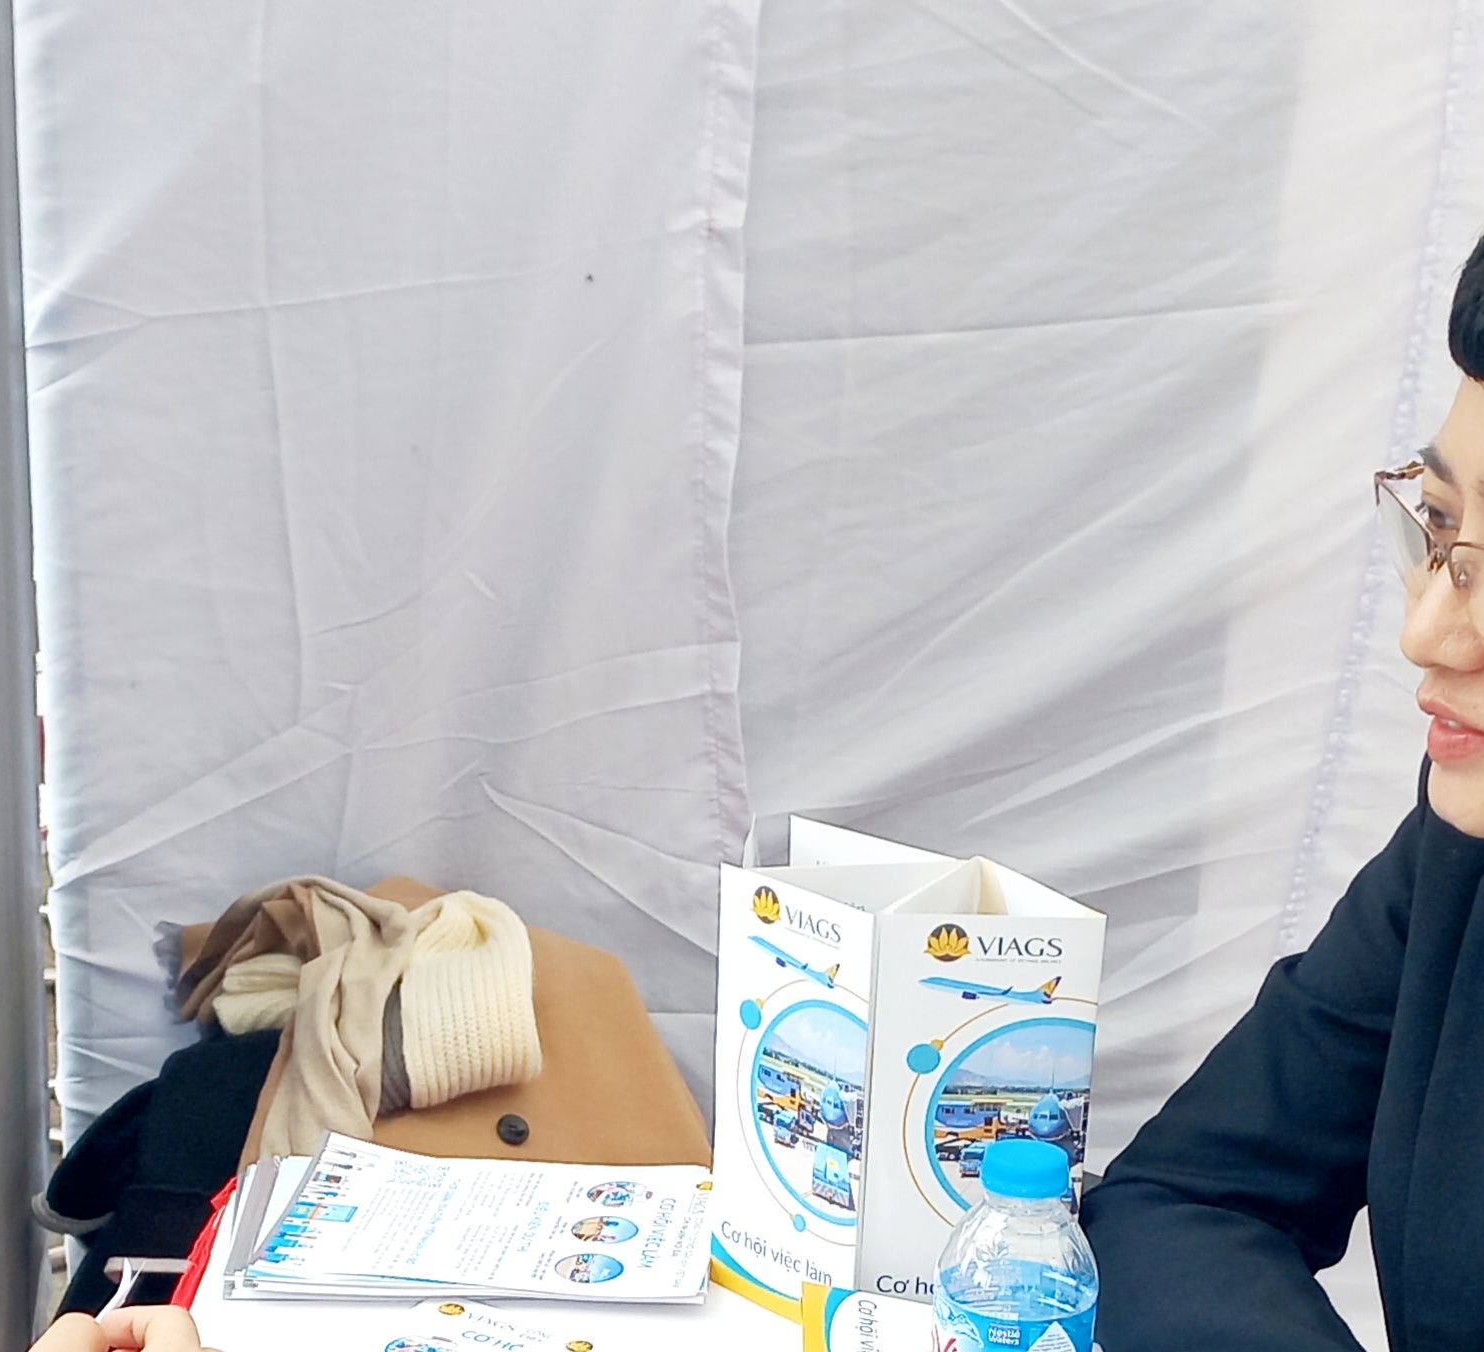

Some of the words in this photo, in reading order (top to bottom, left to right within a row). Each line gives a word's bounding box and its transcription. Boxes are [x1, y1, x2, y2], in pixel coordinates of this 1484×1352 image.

[785, 905, 841, 943] VIAGS
[977, 936, 1063, 958] VIAGS
[721, 1220, 742, 1244] Cơ
[744, 1231, 767, 1259] hội
[771, 1247, 801, 1273] việc
[805, 1258, 832, 1287] làm
[876, 1275, 909, 1294] Cơ
[858, 1300, 877, 1317] Cơ
[854, 1318, 879, 1339] hội
